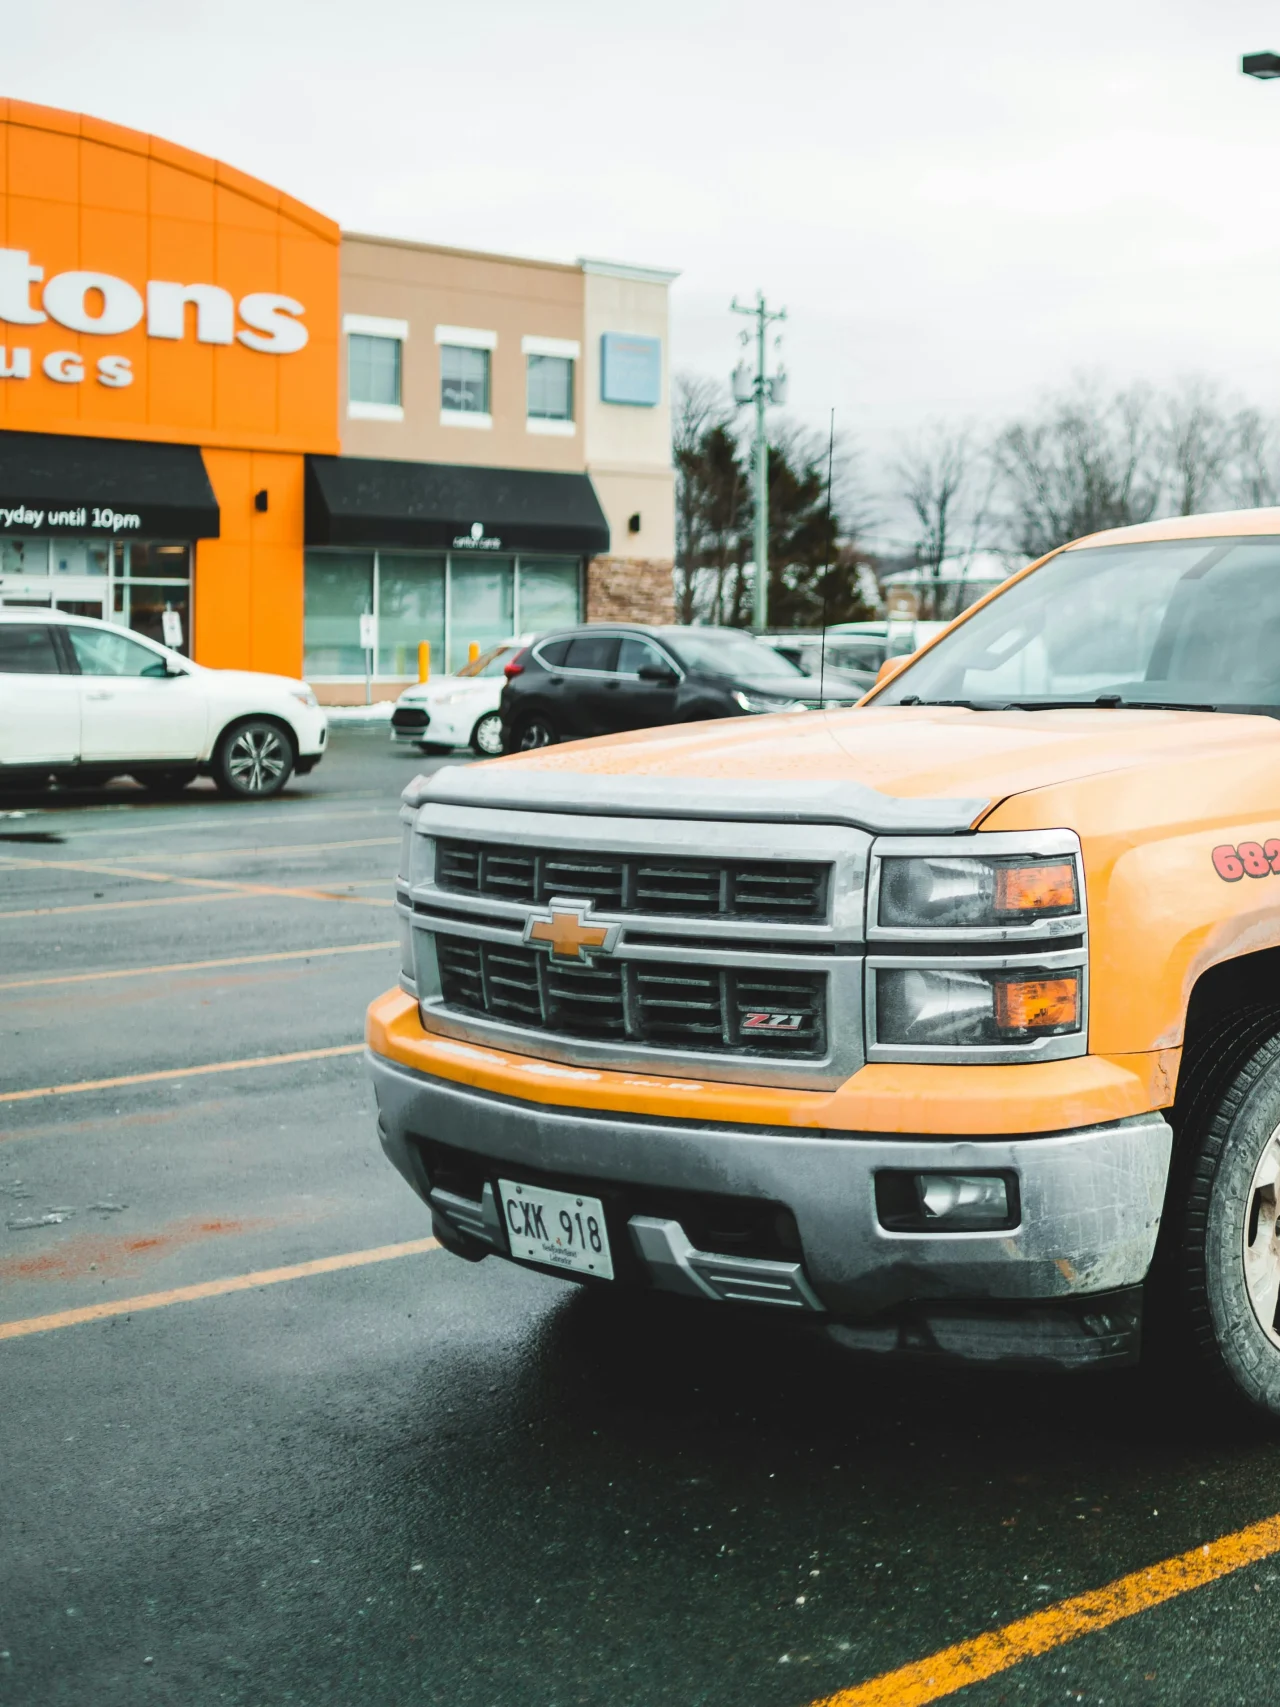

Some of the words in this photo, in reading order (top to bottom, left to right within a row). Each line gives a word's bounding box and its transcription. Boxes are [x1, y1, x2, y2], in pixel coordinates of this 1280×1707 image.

[48, 508, 87, 527] until
[92, 508, 140, 532] 10pm
[743, 1013, 803, 1030] Z71
[507, 1198, 549, 1241] CXK
[559, 1210, 602, 1253] 918
